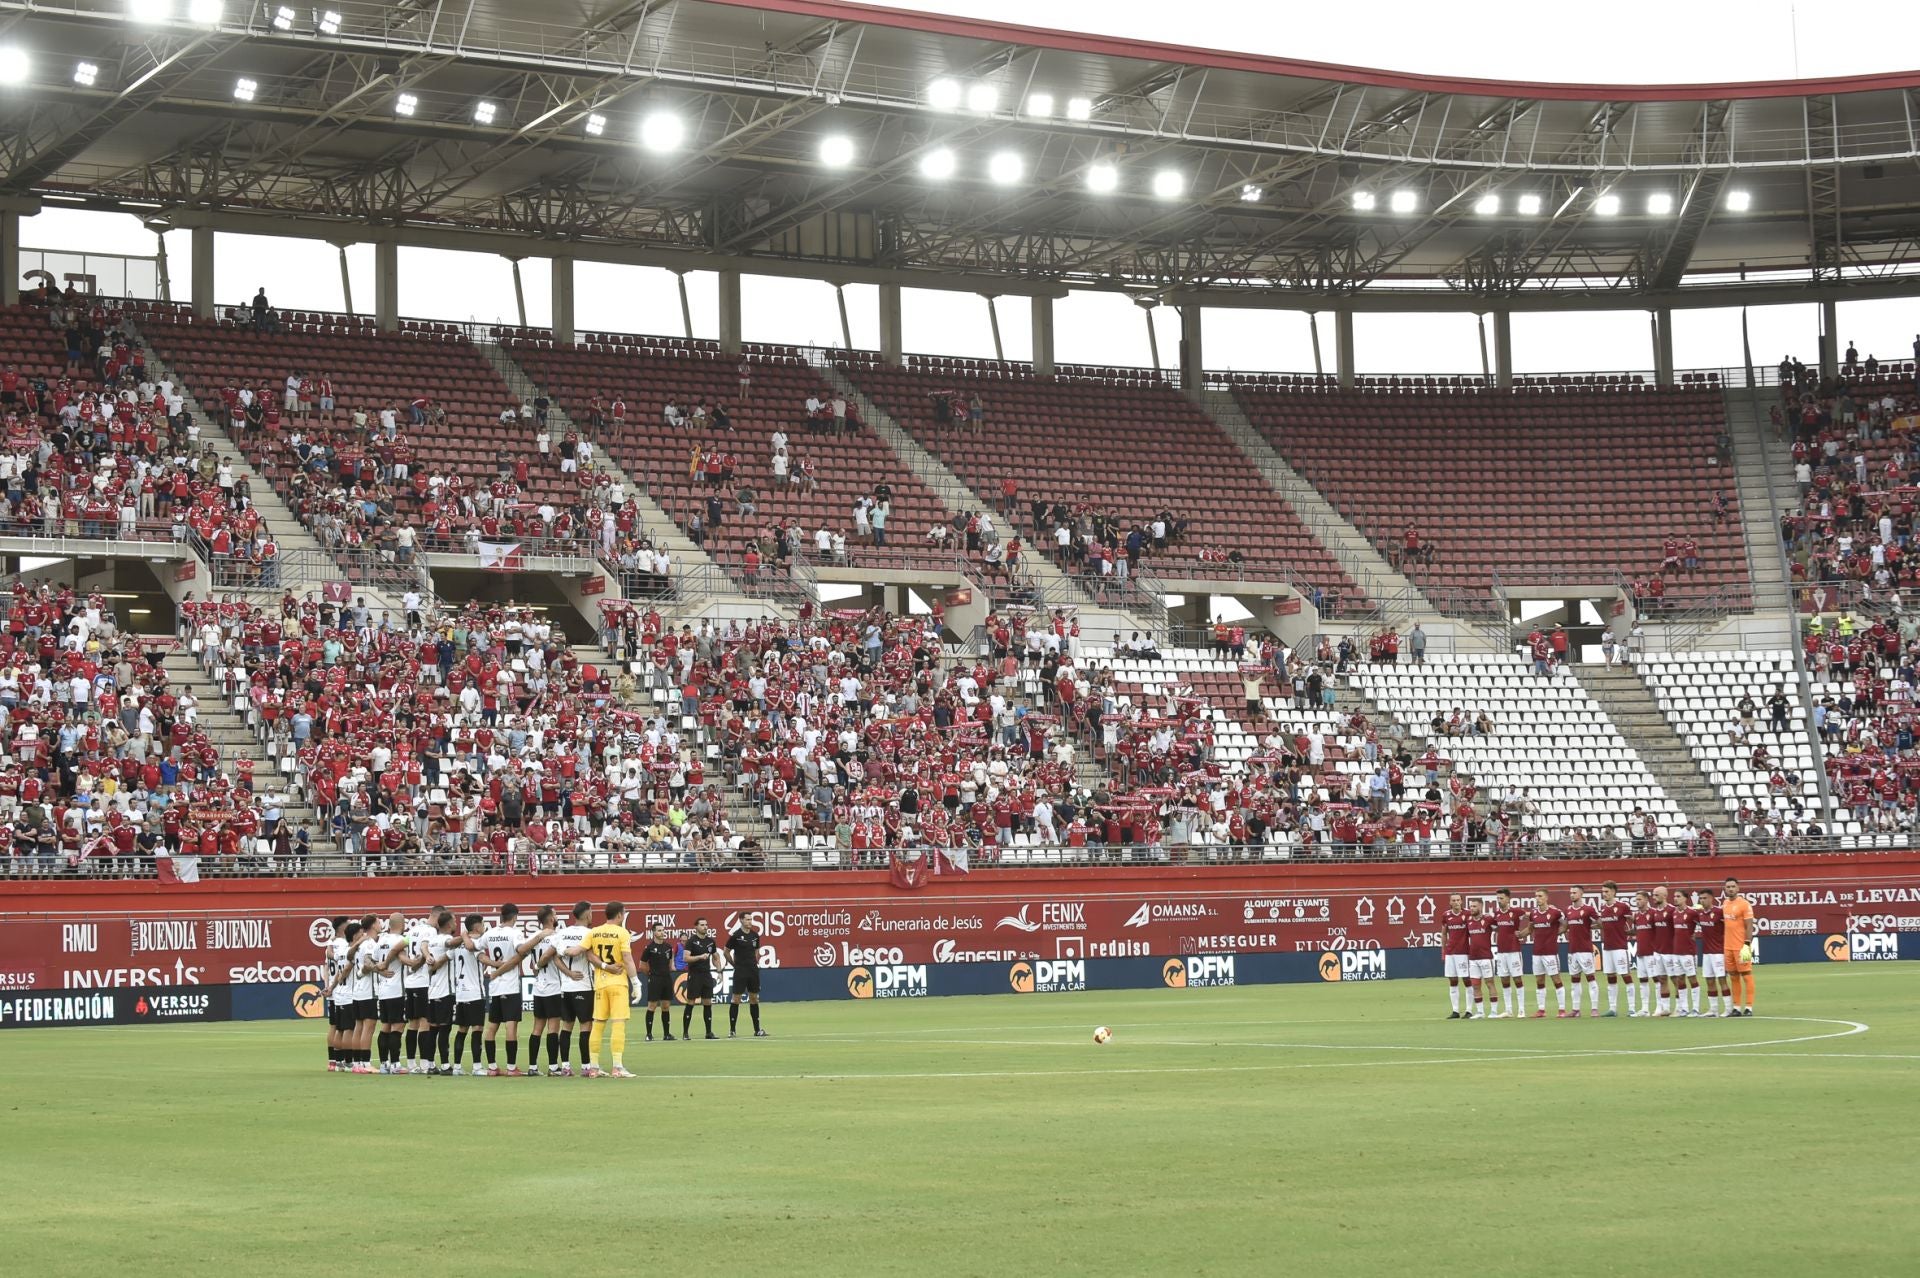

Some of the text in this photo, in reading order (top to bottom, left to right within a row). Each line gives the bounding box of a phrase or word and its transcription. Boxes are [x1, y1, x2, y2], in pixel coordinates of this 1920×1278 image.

[1244, 899, 1329, 908] ALQUIVENT LEVANTE
[1840, 893, 1854, 901] DE
[787, 909, 851, 927] correduría
[1042, 903, 1085, 923] FENIX
[1152, 904, 1219, 917] OMANSA S.L.
[645, 914, 676, 928] FENIX
[874, 915, 983, 931] Funeraria de Jesús
[1042, 923, 1075, 931] INVESTMENTS
[1773, 921, 1814, 929] SPORTS
[62, 924, 98, 952] RMU
[139, 921, 197, 951] BUENDIA
[206, 920, 214, 949] FRUTAS
[214, 920, 272, 949] BUENDIA
[798, 927, 851, 938] de seguros
[1327, 927, 1347, 936] DON
[1090, 939, 1150, 958] redpiso
[1198, 935, 1277, 948] MESEGUER
[1851, 933, 1898, 953] DFM
[597, 944, 616, 965] 13
[841, 941, 904, 967] lesco
[1342, 950, 1386, 973] DFM
[1852, 952, 1874, 960] RENT
[1882, 952, 1898, 960] CAR
[1035, 960, 1085, 983] DFM
[1187, 956, 1234, 979] DFM
[875, 965, 927, 988] DFM
[1188, 977, 1234, 987] RENT A CAR
[1342, 971, 1386, 981] RENT A CAR
[876, 988, 927, 998] RENT A CAR
[1037, 984, 1057, 992] RENT
[1068, 982, 1085, 991] CAR
[15, 993, 114, 1022] FEDERACIÓN
[149, 995, 209, 1008] VERSUS
[156, 1008, 204, 1016] E-LEARNING
